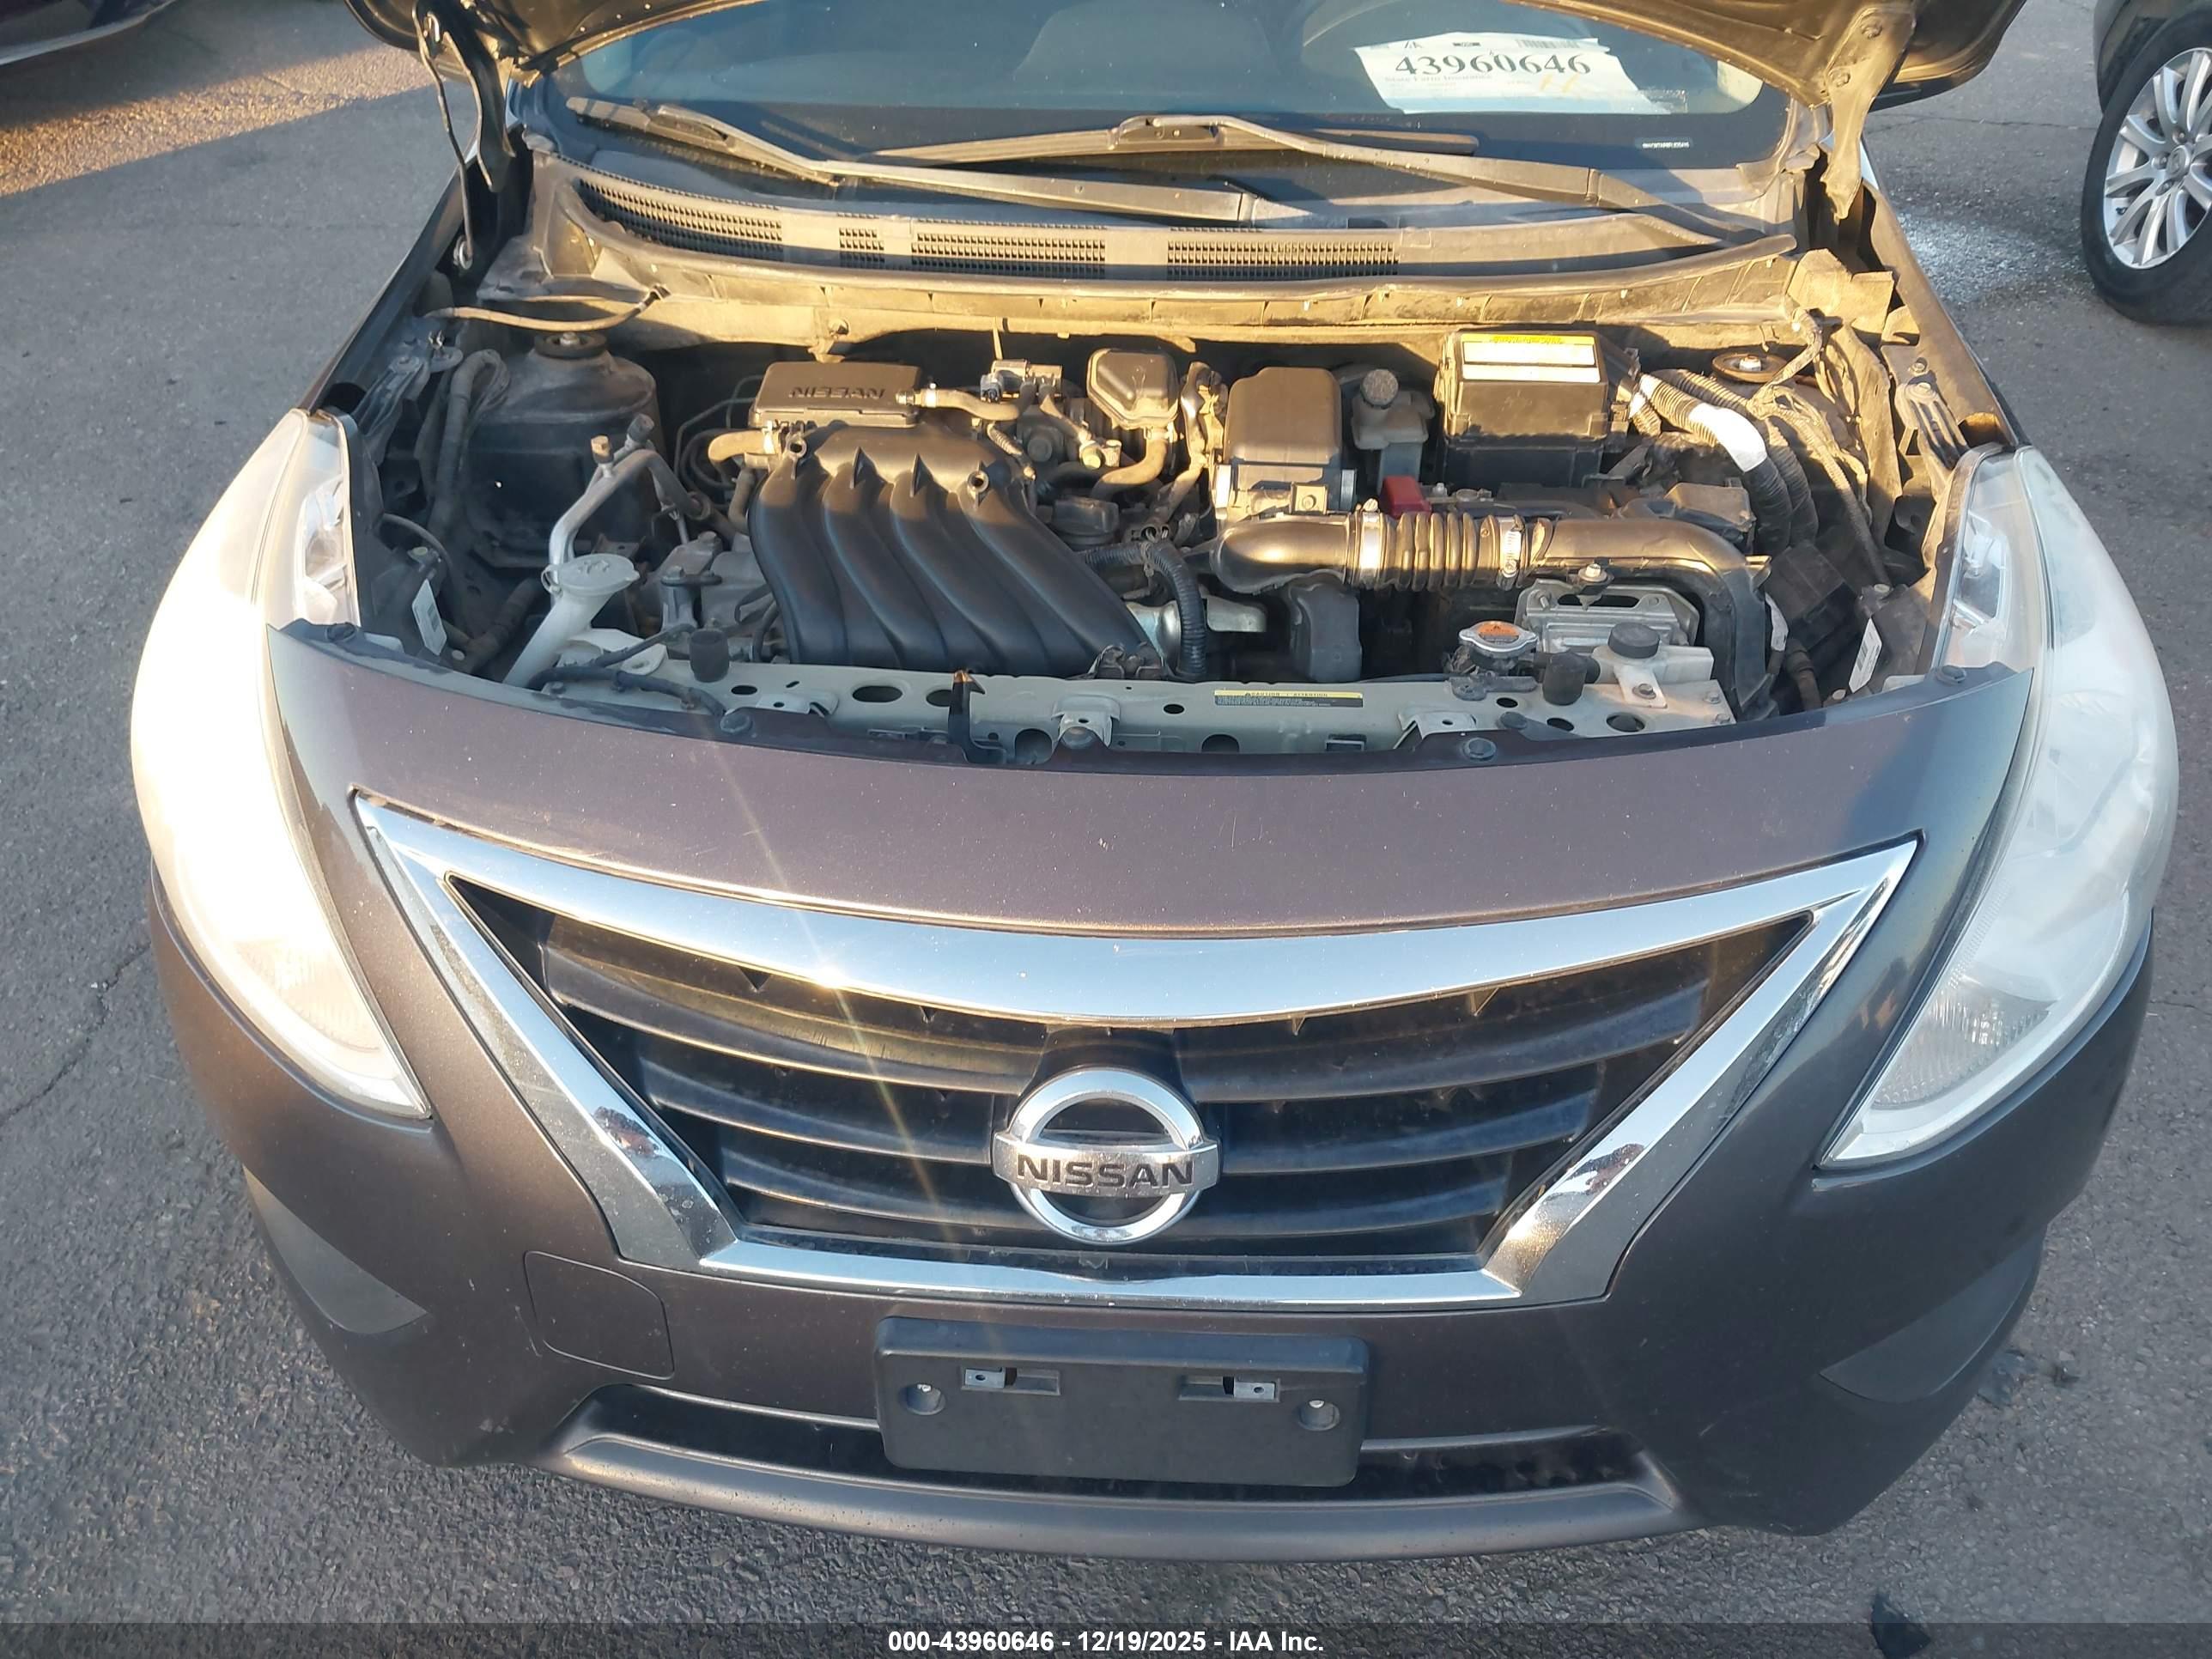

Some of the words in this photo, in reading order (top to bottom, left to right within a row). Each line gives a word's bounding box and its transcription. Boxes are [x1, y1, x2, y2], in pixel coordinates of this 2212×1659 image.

[1395, 54, 1590, 76] 43960646
[788, 386, 886, 399] NISSAN
[1017, 1154, 1194, 1189] NISSAN
